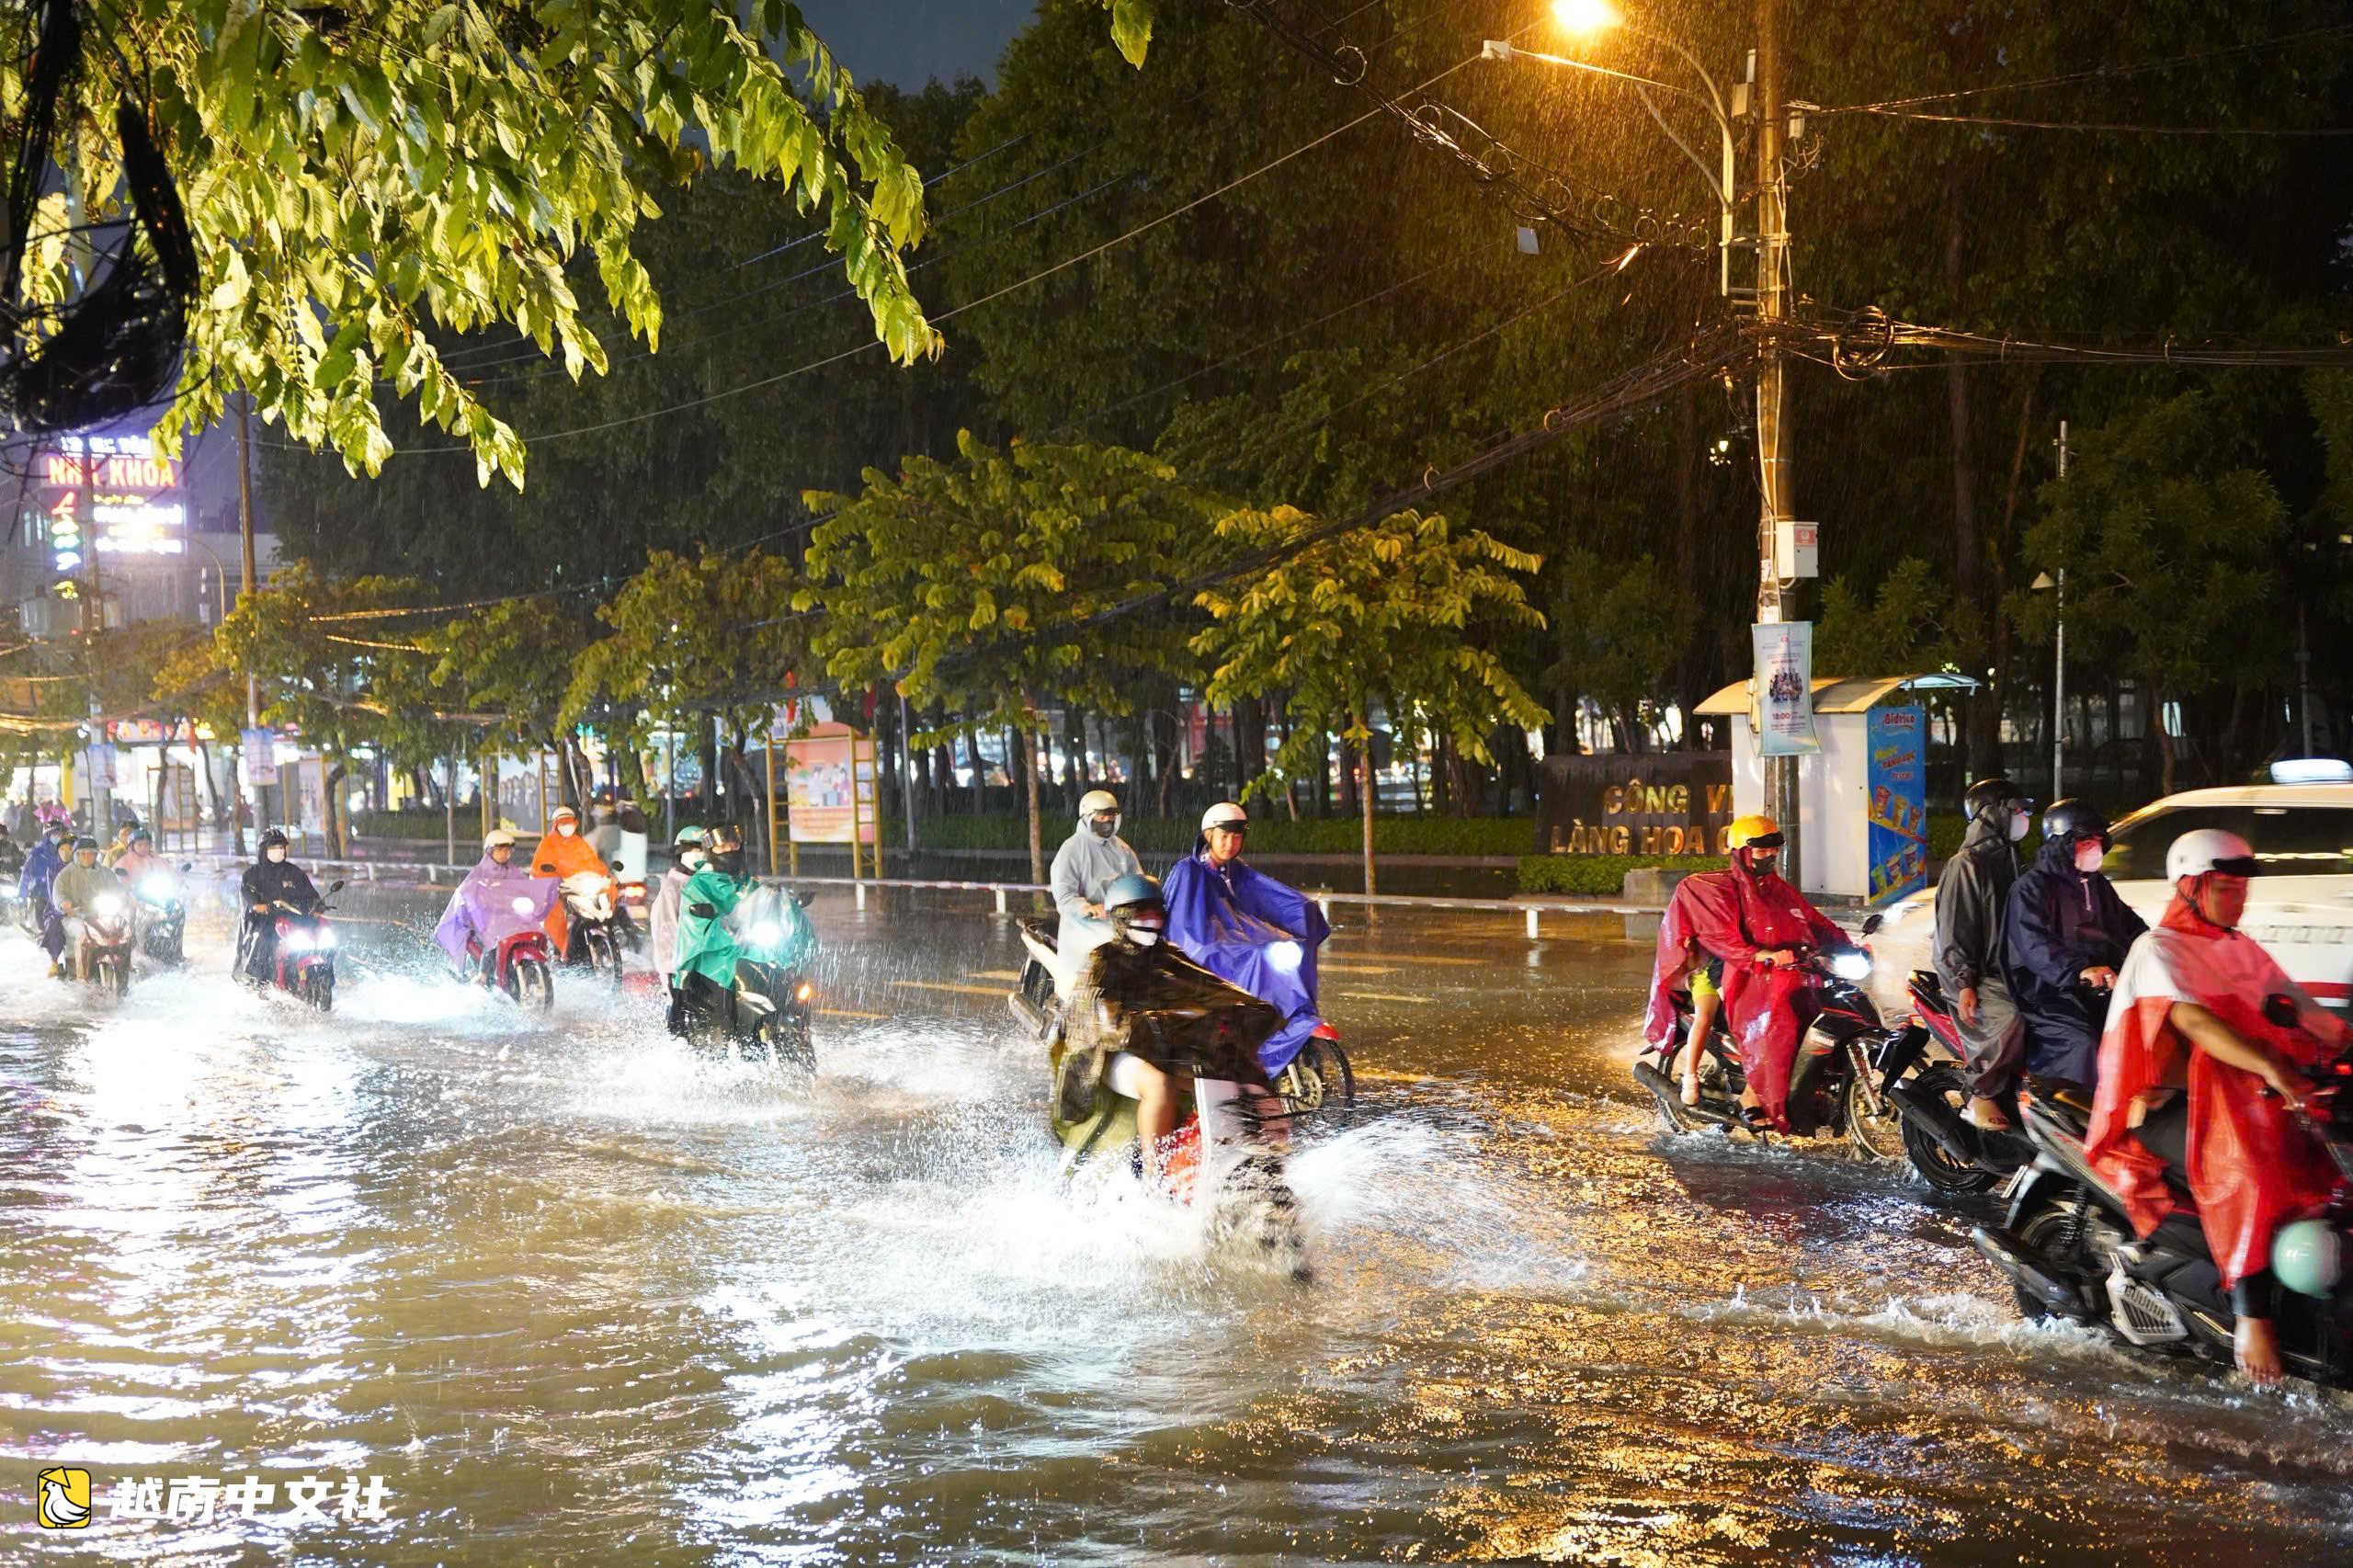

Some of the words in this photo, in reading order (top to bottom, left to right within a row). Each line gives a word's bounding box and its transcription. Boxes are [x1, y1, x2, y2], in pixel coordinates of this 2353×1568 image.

[108, 459, 176, 487] KHOA
[1884, 712, 1915, 725] Bidrico
[1603, 778, 1690, 814] CÔNG
[1705, 785, 1733, 813] VI
[1550, 818, 1631, 854] LÀNG
[1640, 826, 1704, 855] HOA
